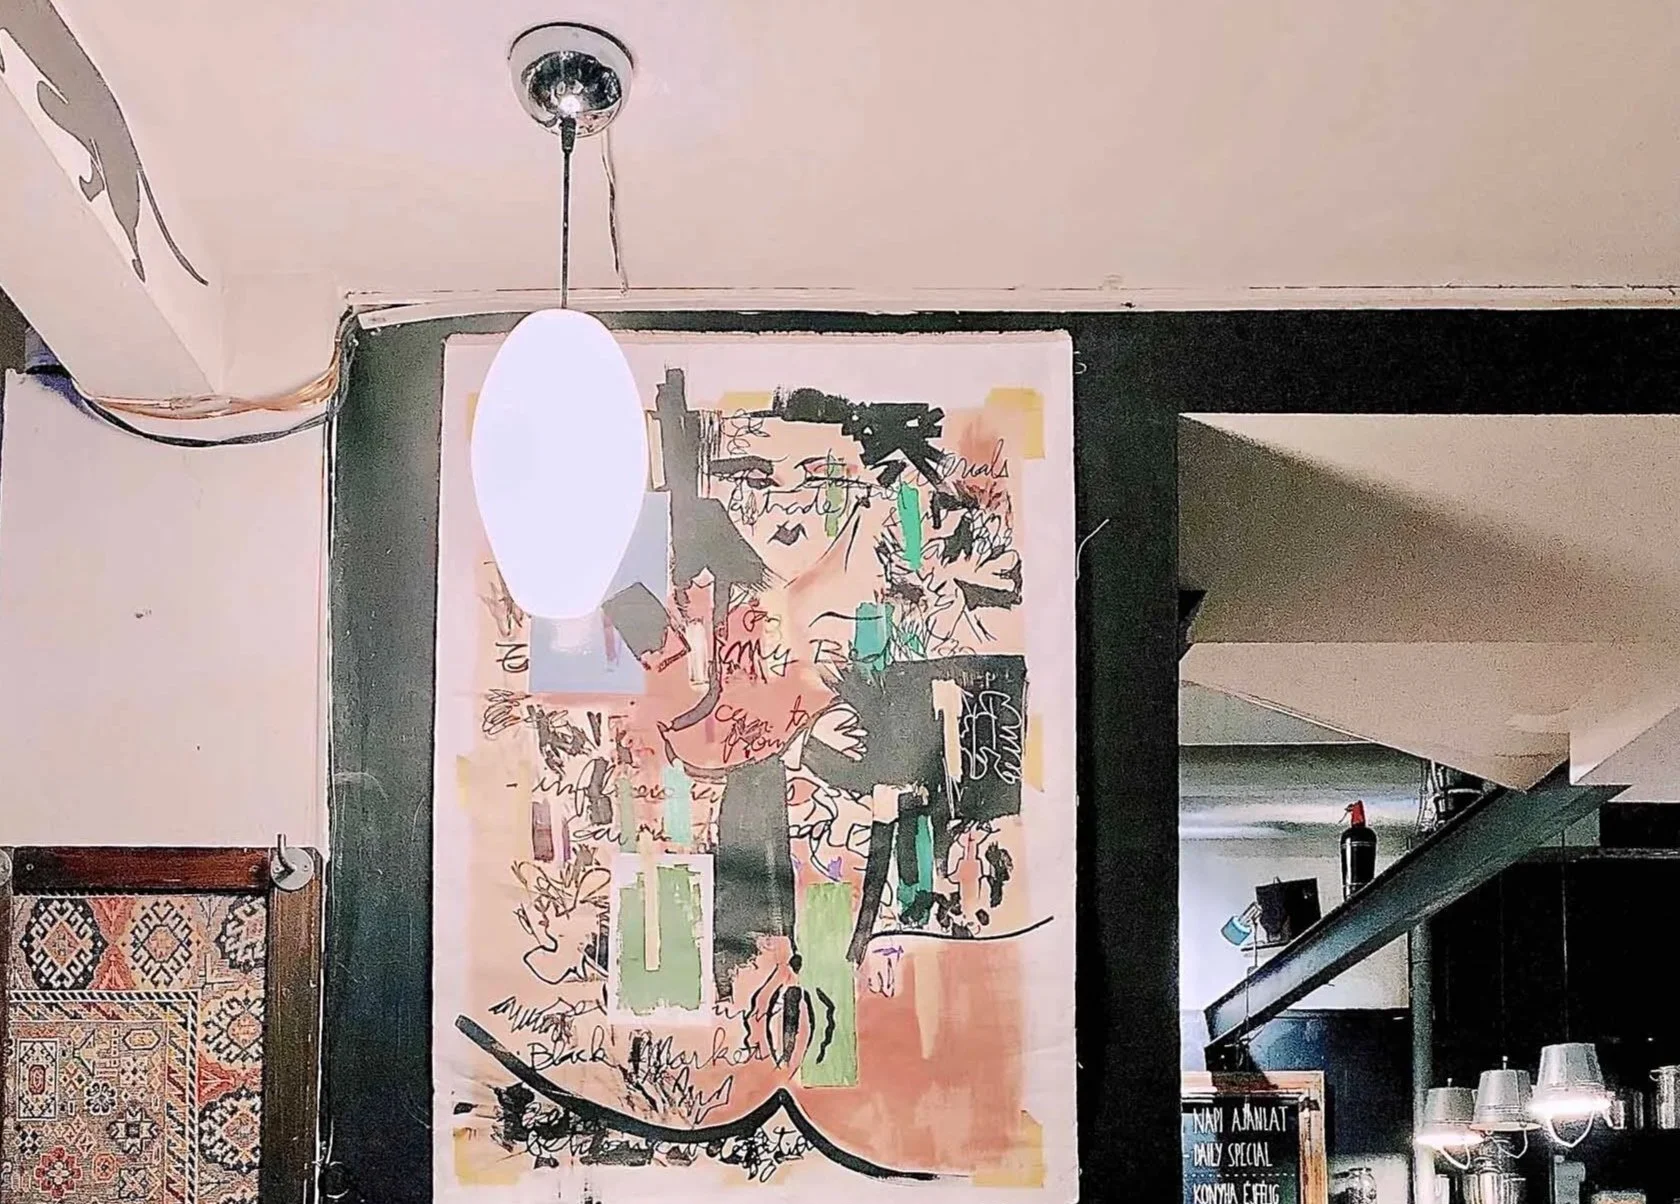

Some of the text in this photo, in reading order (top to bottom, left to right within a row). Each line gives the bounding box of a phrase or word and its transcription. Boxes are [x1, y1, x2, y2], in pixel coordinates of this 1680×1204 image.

[1192, 1107, 1223, 1134] NAPI
[1194, 1142, 1272, 1167] DAILY SPECIAL
